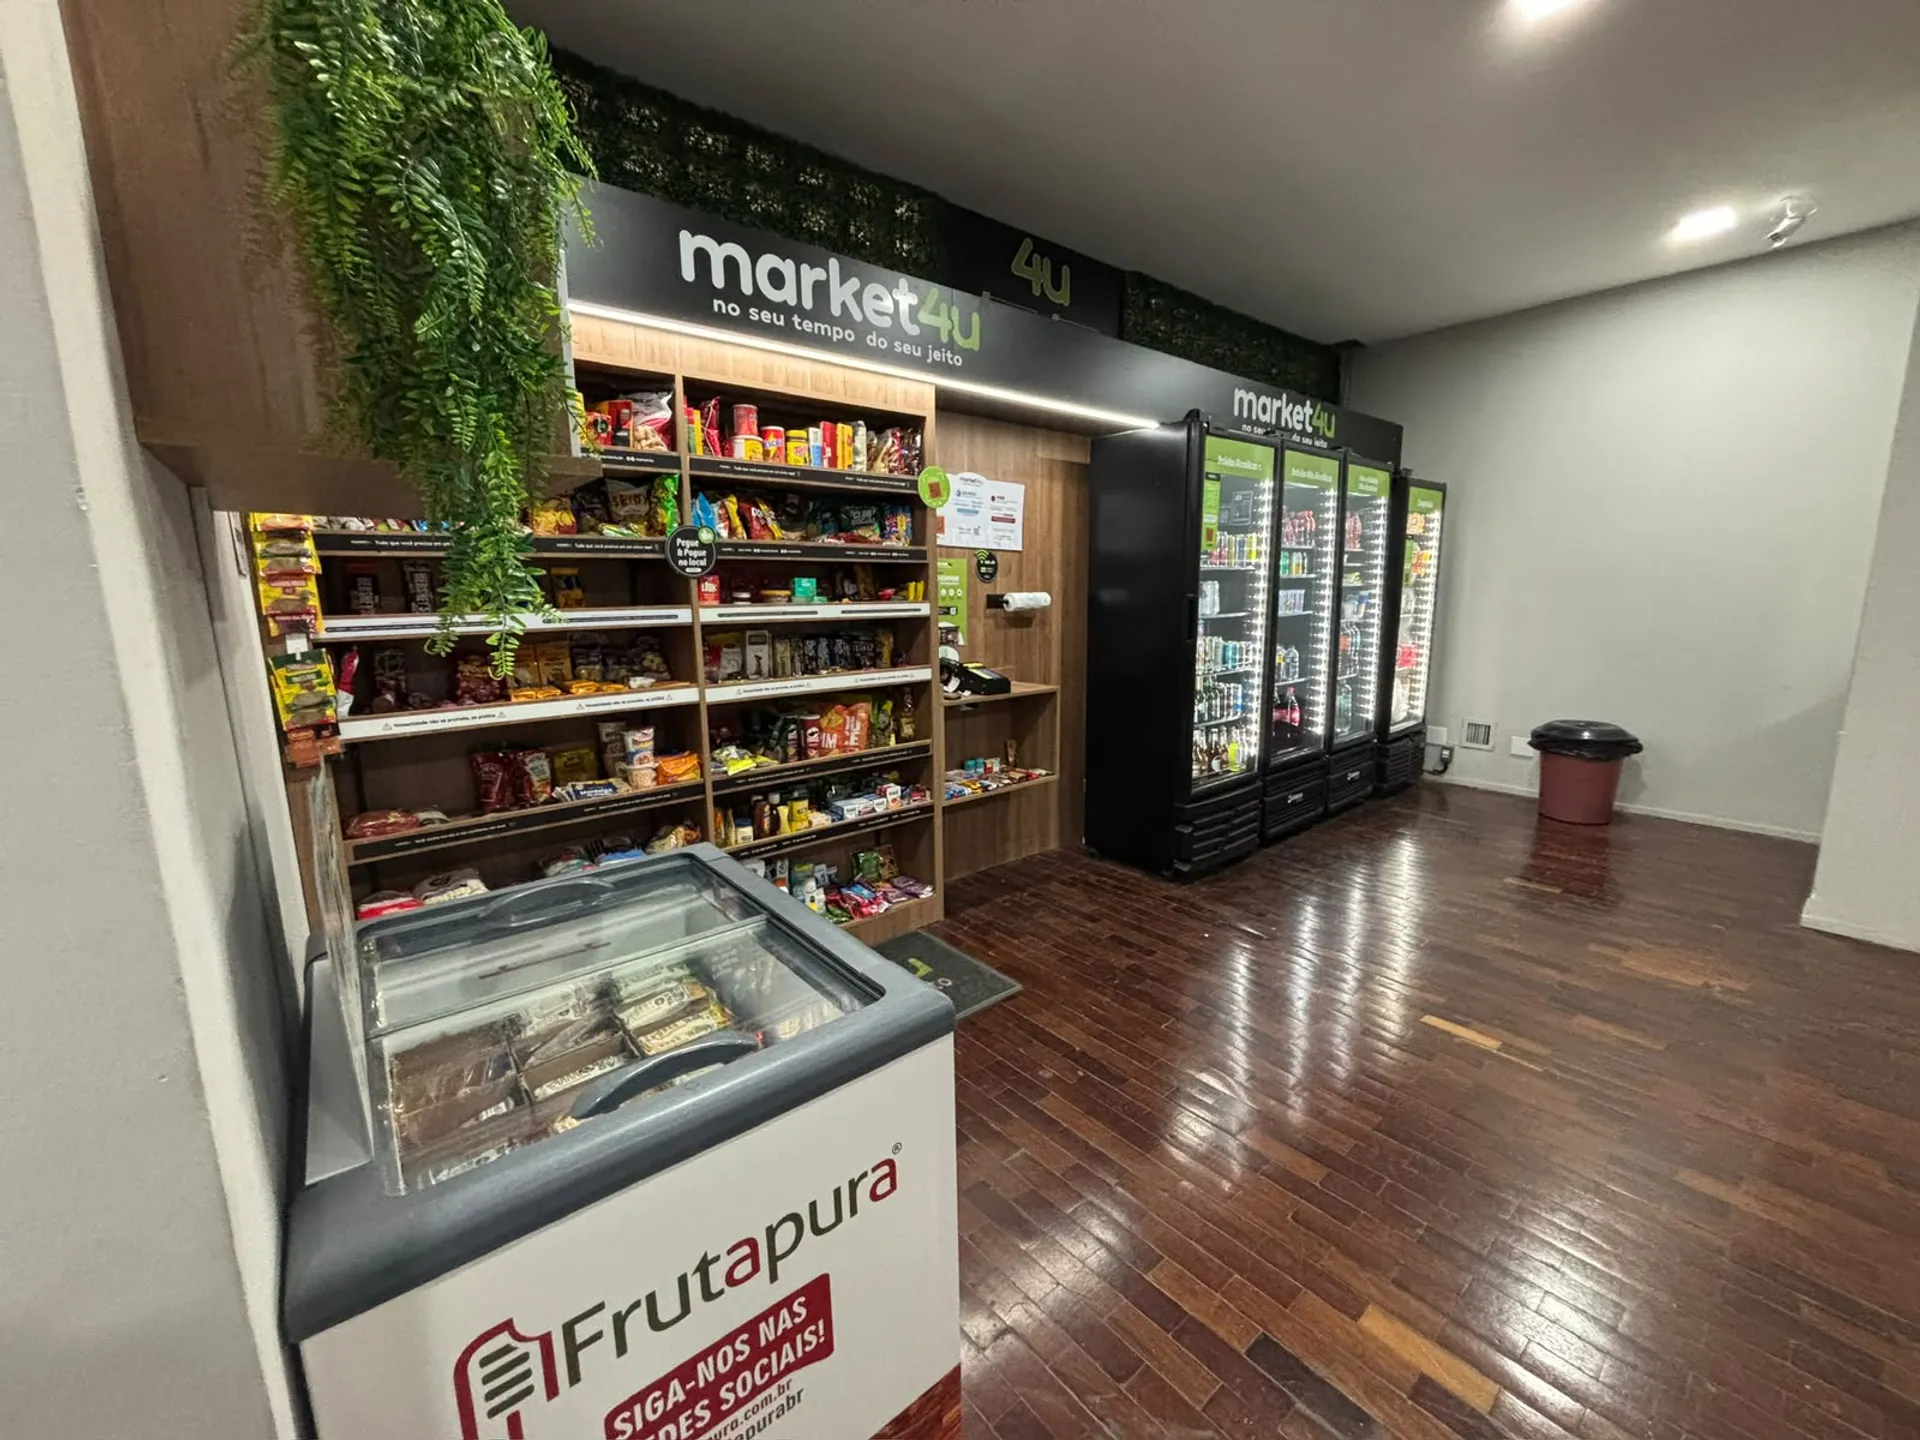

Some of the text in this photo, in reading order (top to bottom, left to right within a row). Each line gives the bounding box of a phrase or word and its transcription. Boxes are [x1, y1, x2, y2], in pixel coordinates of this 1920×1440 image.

[678, 229, 981, 350] market4u
[1011, 238, 1070, 306] 4u
[712, 296, 963, 367] no seu tempo do seu jeito
[1234, 388, 1335, 439] market4u
[1242, 424, 1252, 432] no
[1302, 437, 1313, 446] seu
[676, 537, 699, 548] Pegue
[684, 548, 707, 558] Pague
[689, 557, 707, 566] local
[562, 1157, 897, 1387] Frutapura
[612, 1296, 807, 1440] SIGA-NOS NAS
[645, 1319, 826, 1440] DES SOCIAIS!
[706, 1377, 793, 1440] ura.com.br
